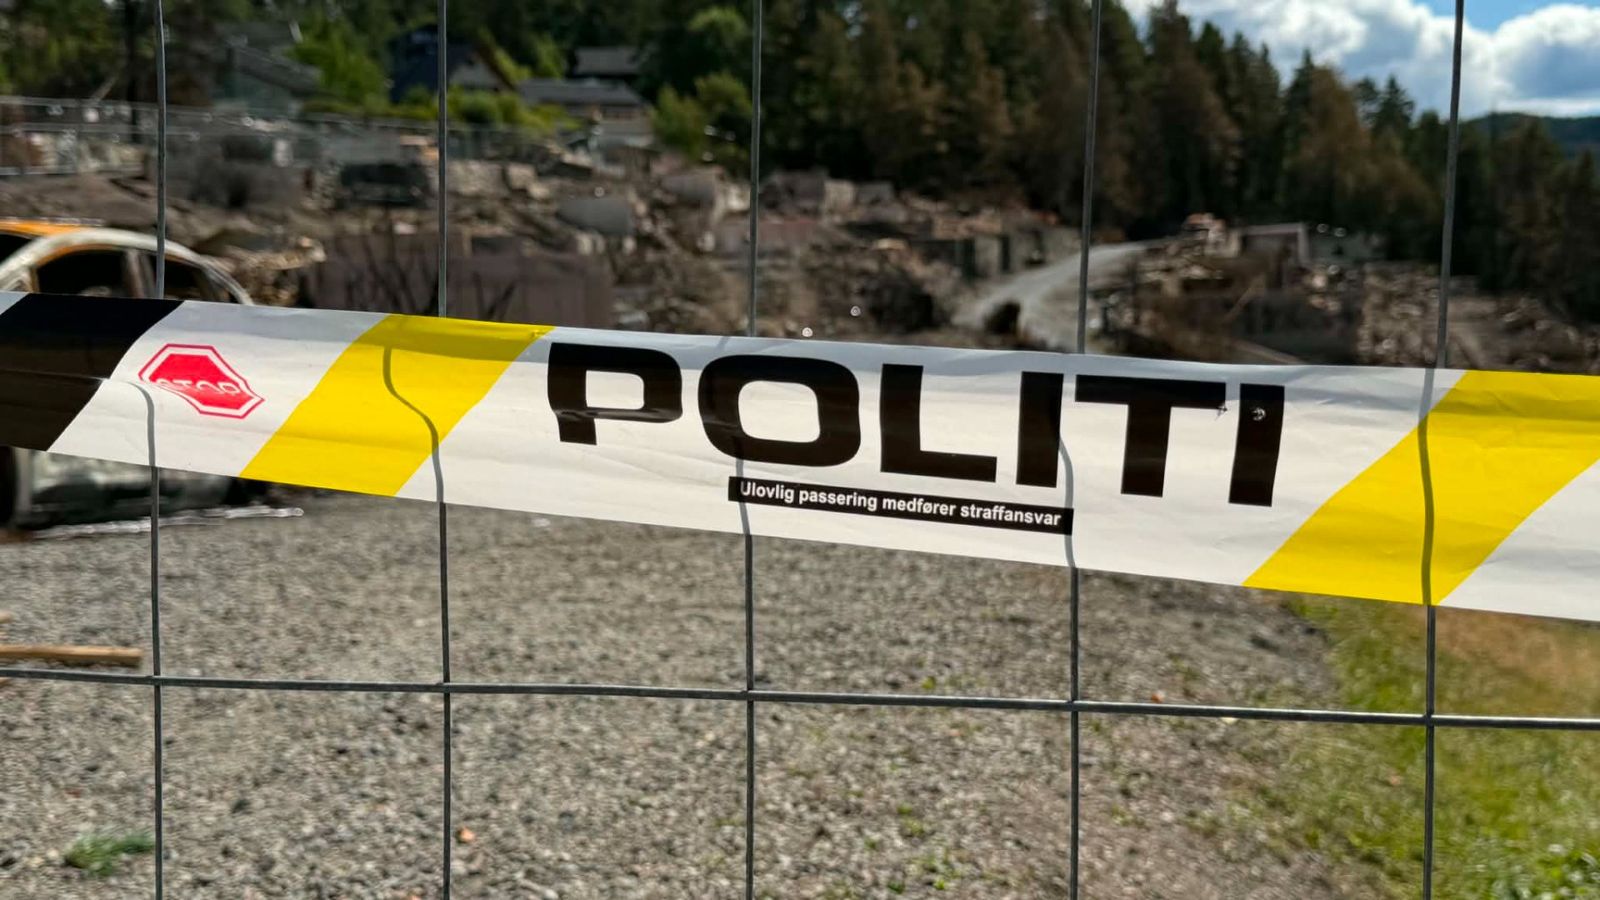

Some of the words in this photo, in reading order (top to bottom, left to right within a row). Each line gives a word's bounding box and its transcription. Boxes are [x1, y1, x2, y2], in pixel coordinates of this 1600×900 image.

[547, 342, 1286, 507] POLITI
[740, 481, 795, 504] Ulovlig
[799, 489, 878, 511] passering
[882, 497, 956, 516] medfører
[960, 504, 1062, 526] straffansvar
